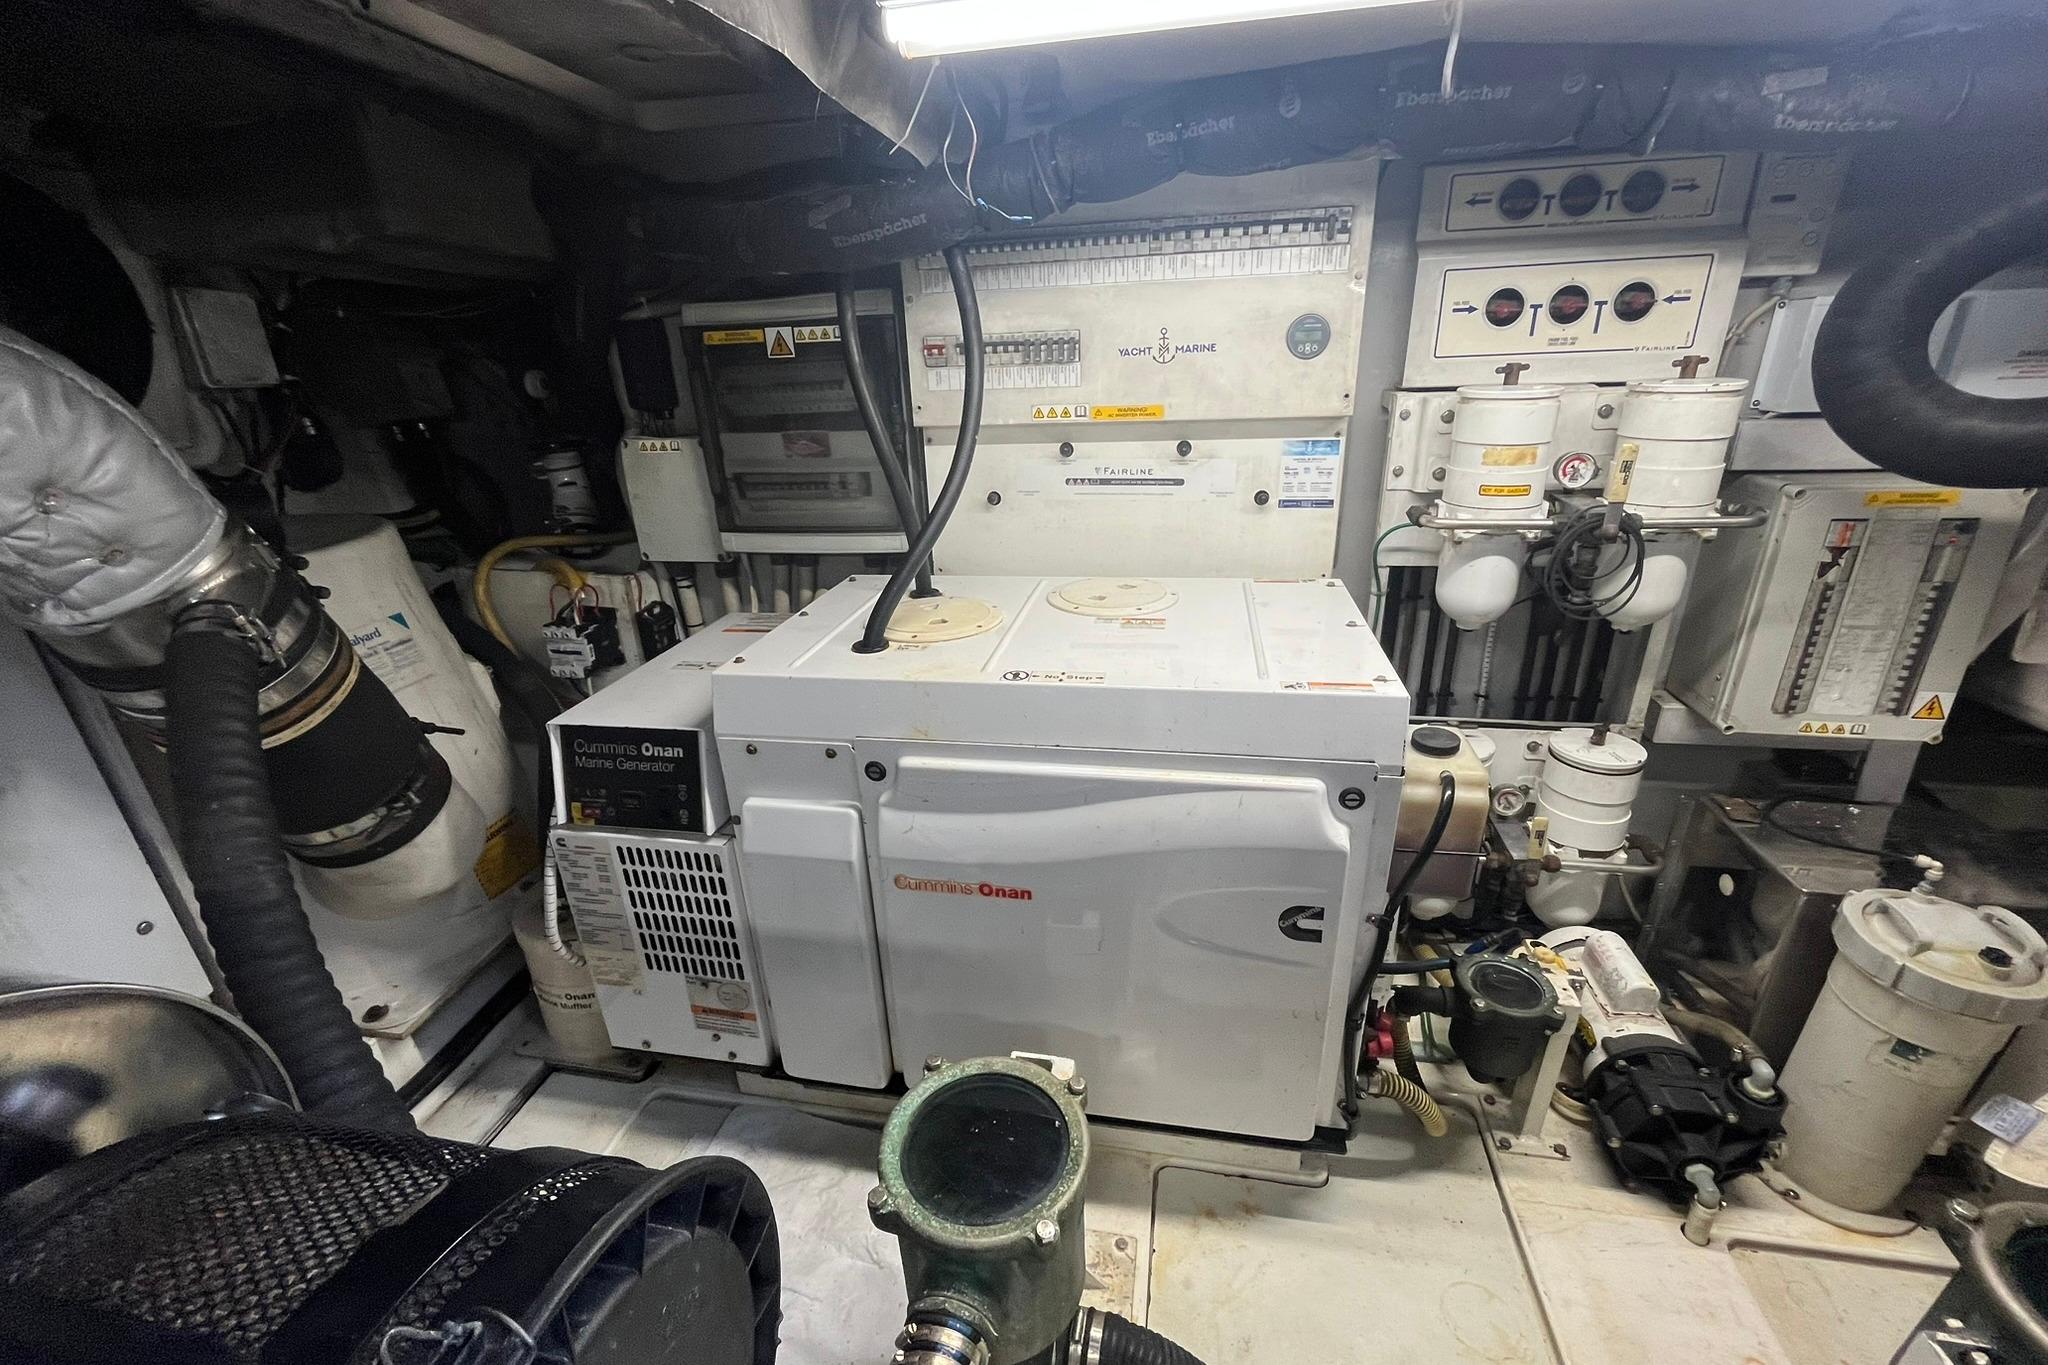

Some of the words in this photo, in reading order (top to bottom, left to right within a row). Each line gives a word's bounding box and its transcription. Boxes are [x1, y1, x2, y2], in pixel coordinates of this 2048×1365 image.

[1118, 346, 1153, 357] YACHT
[1175, 343, 1217, 354] MARINE
[1103, 466, 1154, 476] FAIRLINE
[351, 627, 382, 647] alyard
[574, 738, 637, 756] Cummins
[641, 742, 684, 758] Onan
[575, 755, 613, 769] Marine
[616, 757, 675, 773] Generator
[895, 873, 973, 896] Cummins
[978, 882, 1032, 900] Onan
[564, 992, 596, 1001] Onan
